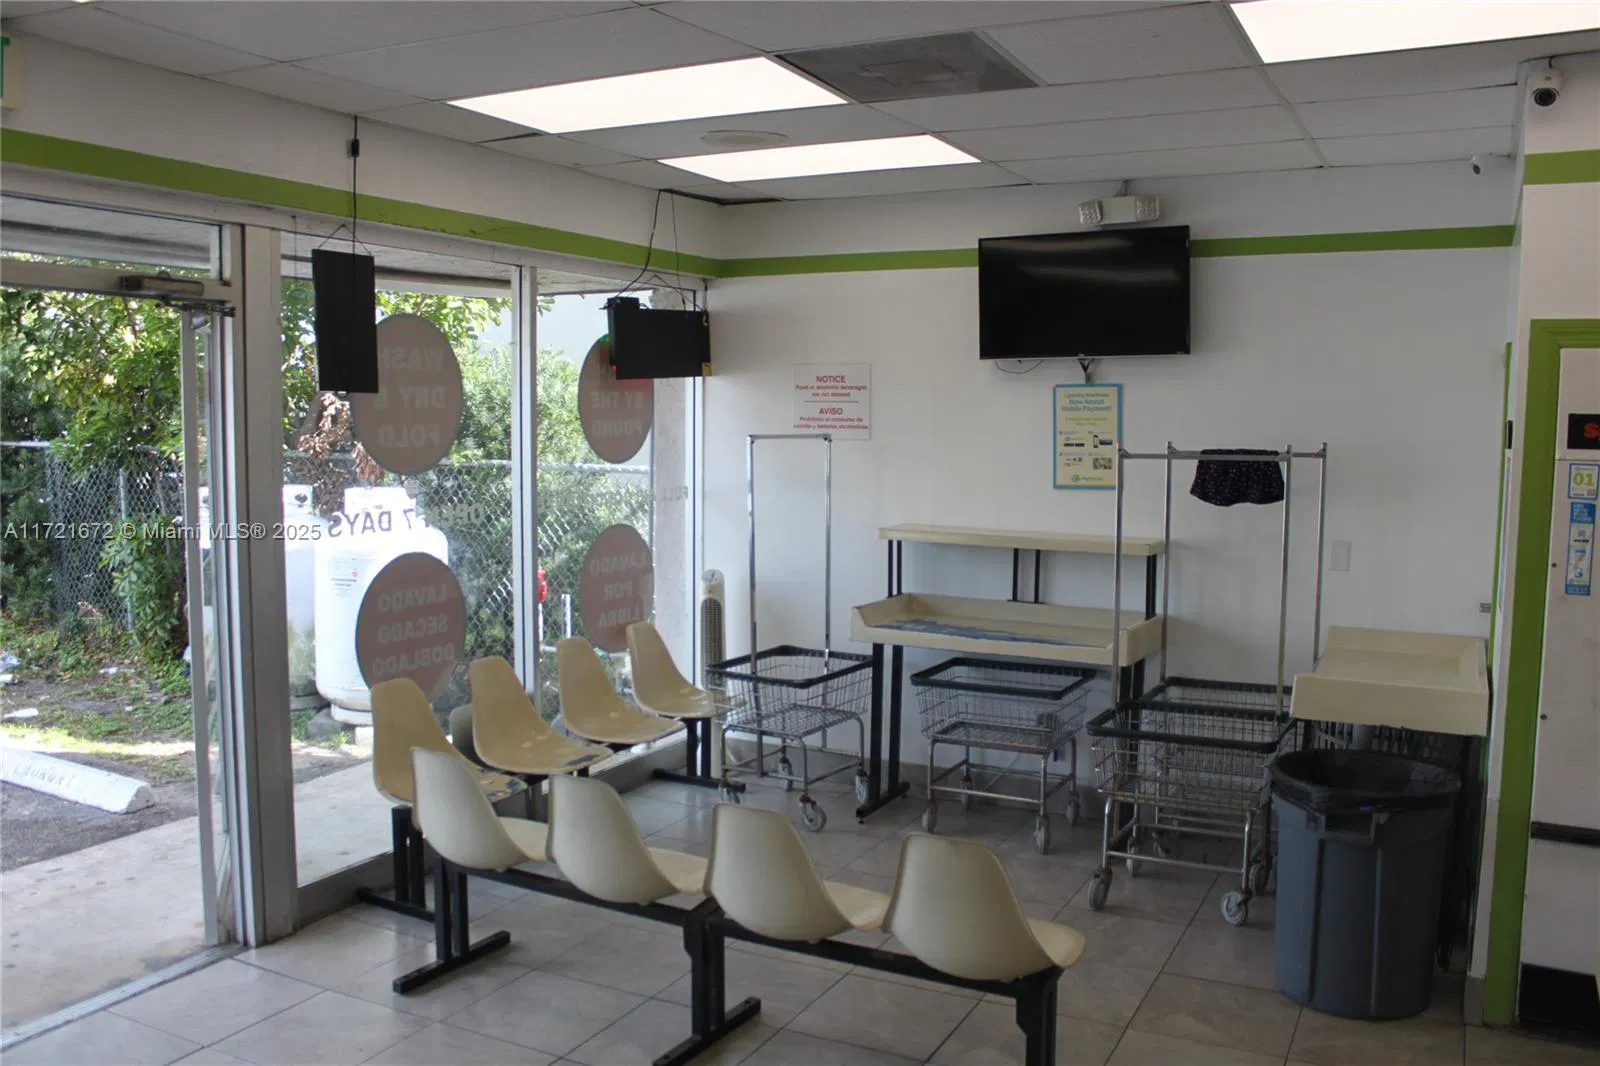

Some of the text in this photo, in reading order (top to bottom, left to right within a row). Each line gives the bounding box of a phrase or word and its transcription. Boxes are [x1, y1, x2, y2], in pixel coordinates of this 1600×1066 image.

[816, 375, 847, 383] NOTICE
[819, 407, 844, 415] AVISO
[1573, 472, 1594, 486] 01
